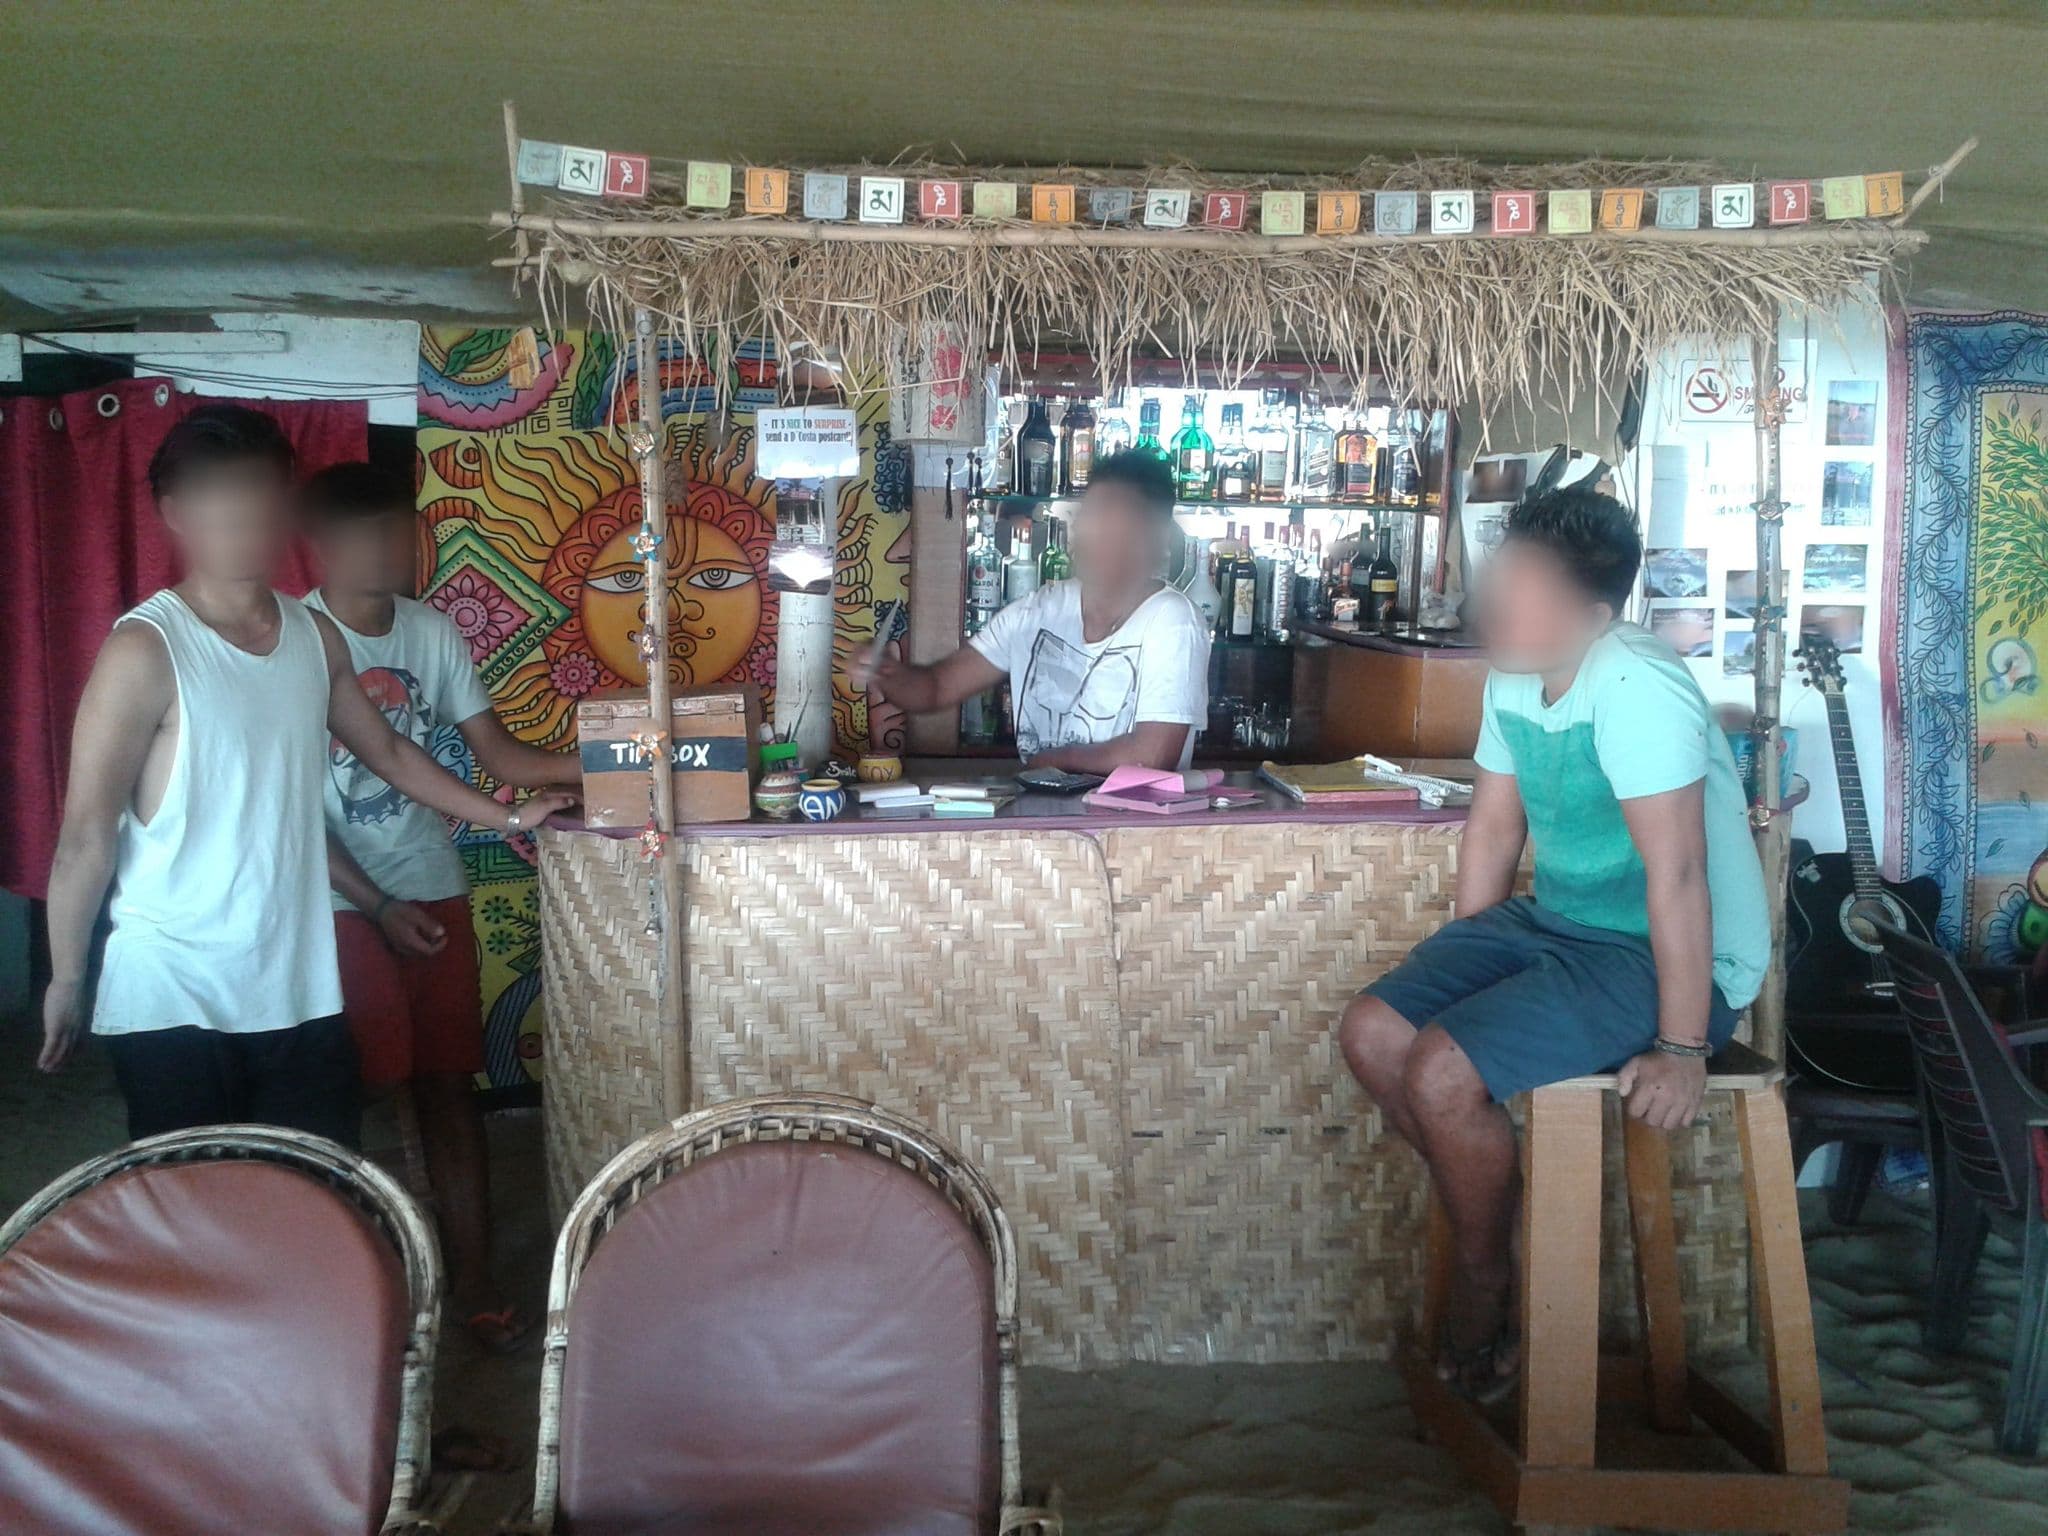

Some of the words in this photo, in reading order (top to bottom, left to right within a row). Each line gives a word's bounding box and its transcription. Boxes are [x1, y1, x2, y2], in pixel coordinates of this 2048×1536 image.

[803, 418, 812, 429] TO
[814, 418, 847, 429] SURPRISE
[766, 432, 782, 442] send
[826, 761, 857, 778] Smile
[863, 765, 894, 782] JOY
